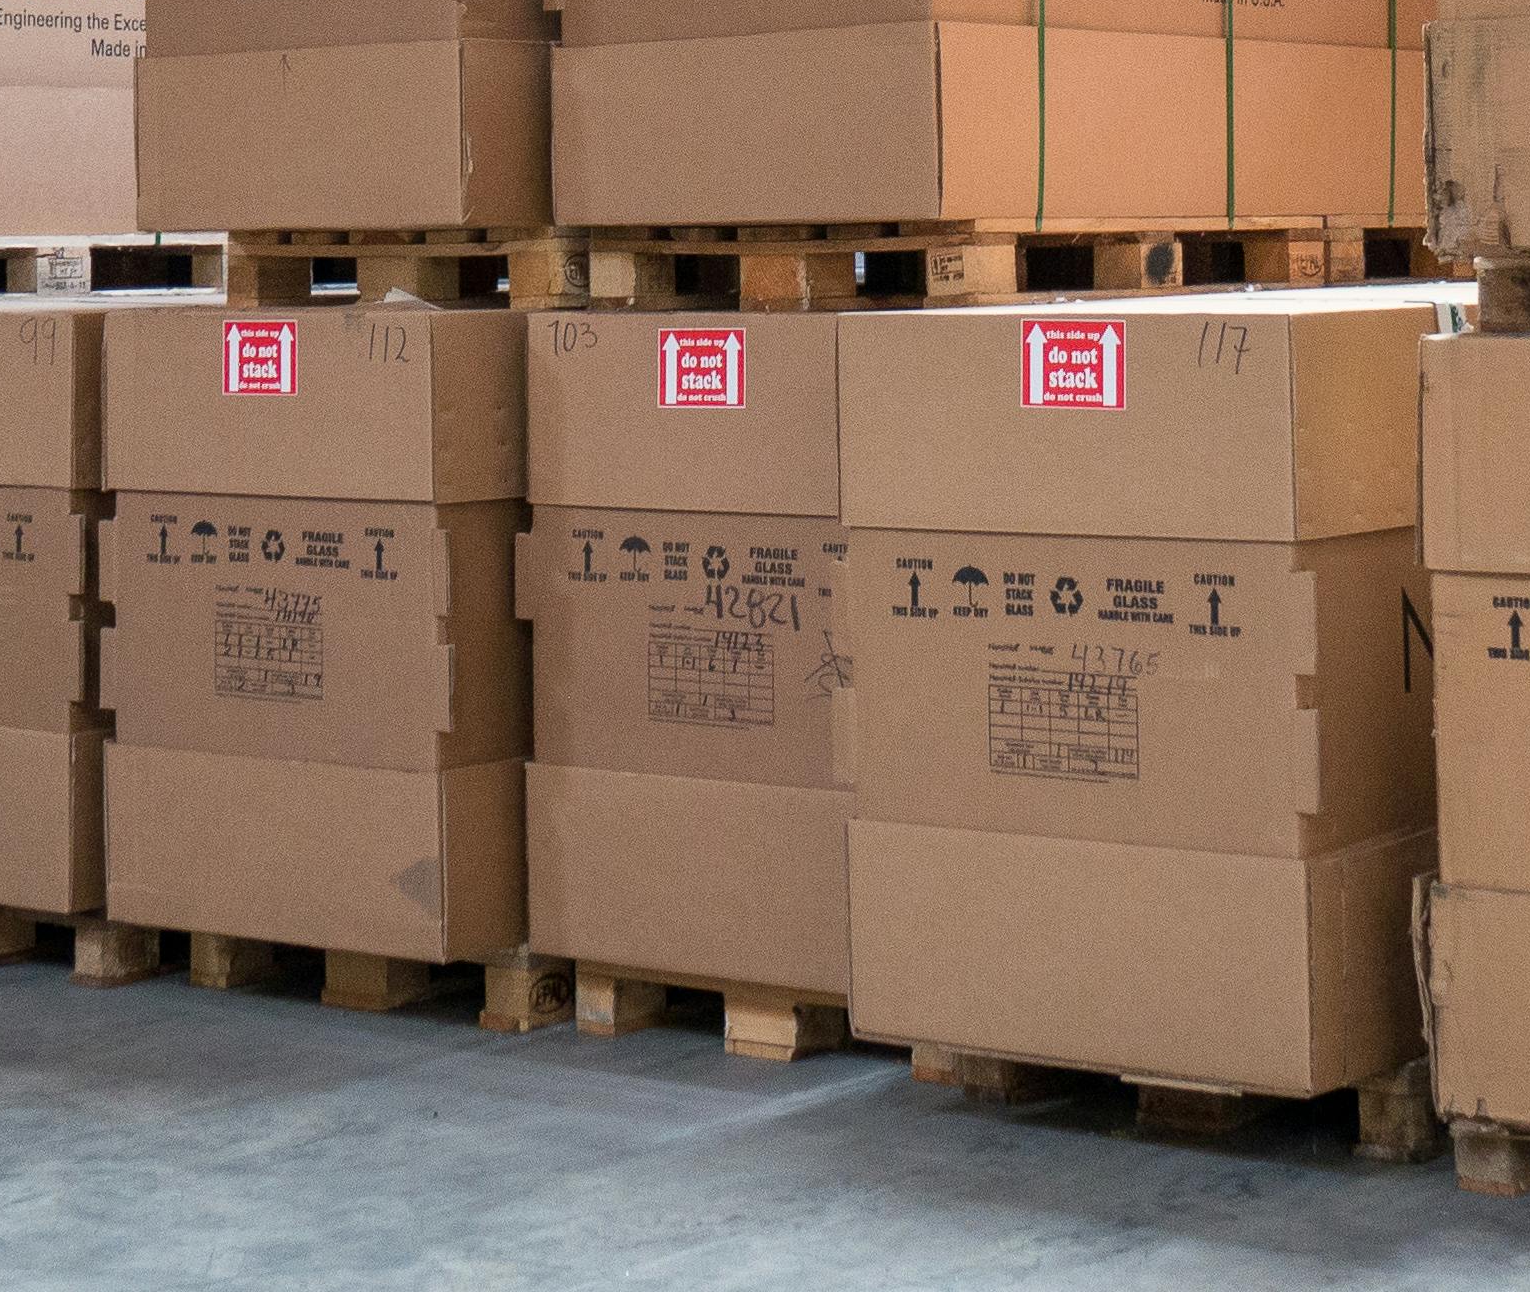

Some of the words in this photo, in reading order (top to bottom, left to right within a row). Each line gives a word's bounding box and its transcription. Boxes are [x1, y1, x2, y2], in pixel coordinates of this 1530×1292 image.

[87, 13, 109, 30] the
[91, 38, 130, 58] Made
[20, 317, 56, 366] 99
[370, 323, 410, 363] 112
[548, 320, 598, 356] 103
[679, 338, 696, 347] this
[697, 338, 712, 347] side
[713, 339, 725, 348] up
[1046, 330, 1065, 340] this
[1067, 330, 1085, 341] side
[1087, 332, 1100, 342] up
[242, 342, 256, 358] do
[259, 344, 277, 358] not
[1049, 346, 1067, 364] do
[1071, 347, 1098, 364] not
[1198, 320, 1250, 375] 117
[681, 352, 697, 368] do
[700, 353, 722, 368] not
[242, 359, 277, 379] stack
[681, 371, 722, 390] stack
[1049, 367, 1098, 388] stack
[677, 393, 686, 402] do
[687, 394, 702, 402] not
[703, 393, 727, 402] crush
[1044, 393, 1055, 401] do
[1056, 393, 1074, 401] not
[1076, 393, 1102, 402] crush
[302, 530, 343, 544] FRAGILE
[572, 529, 604, 540] CAUTION
[306, 544, 339, 557] GLASS
[750, 547, 798, 561] FRAGILE
[755, 561, 793, 575] GLASS
[896, 558, 934, 570] CAUTION
[1004, 573, 1016, 585] DO
[1018, 574, 1036, 586] NOT
[1106, 578, 1164, 595] FRAGILE
[1194, 573, 1236, 587] CAUTION
[1006, 589, 1034, 602] STACK
[1113, 595, 1158, 610] GLASS
[706, 583, 801, 632] 42821
[1005, 604, 1034, 618] GLASS
